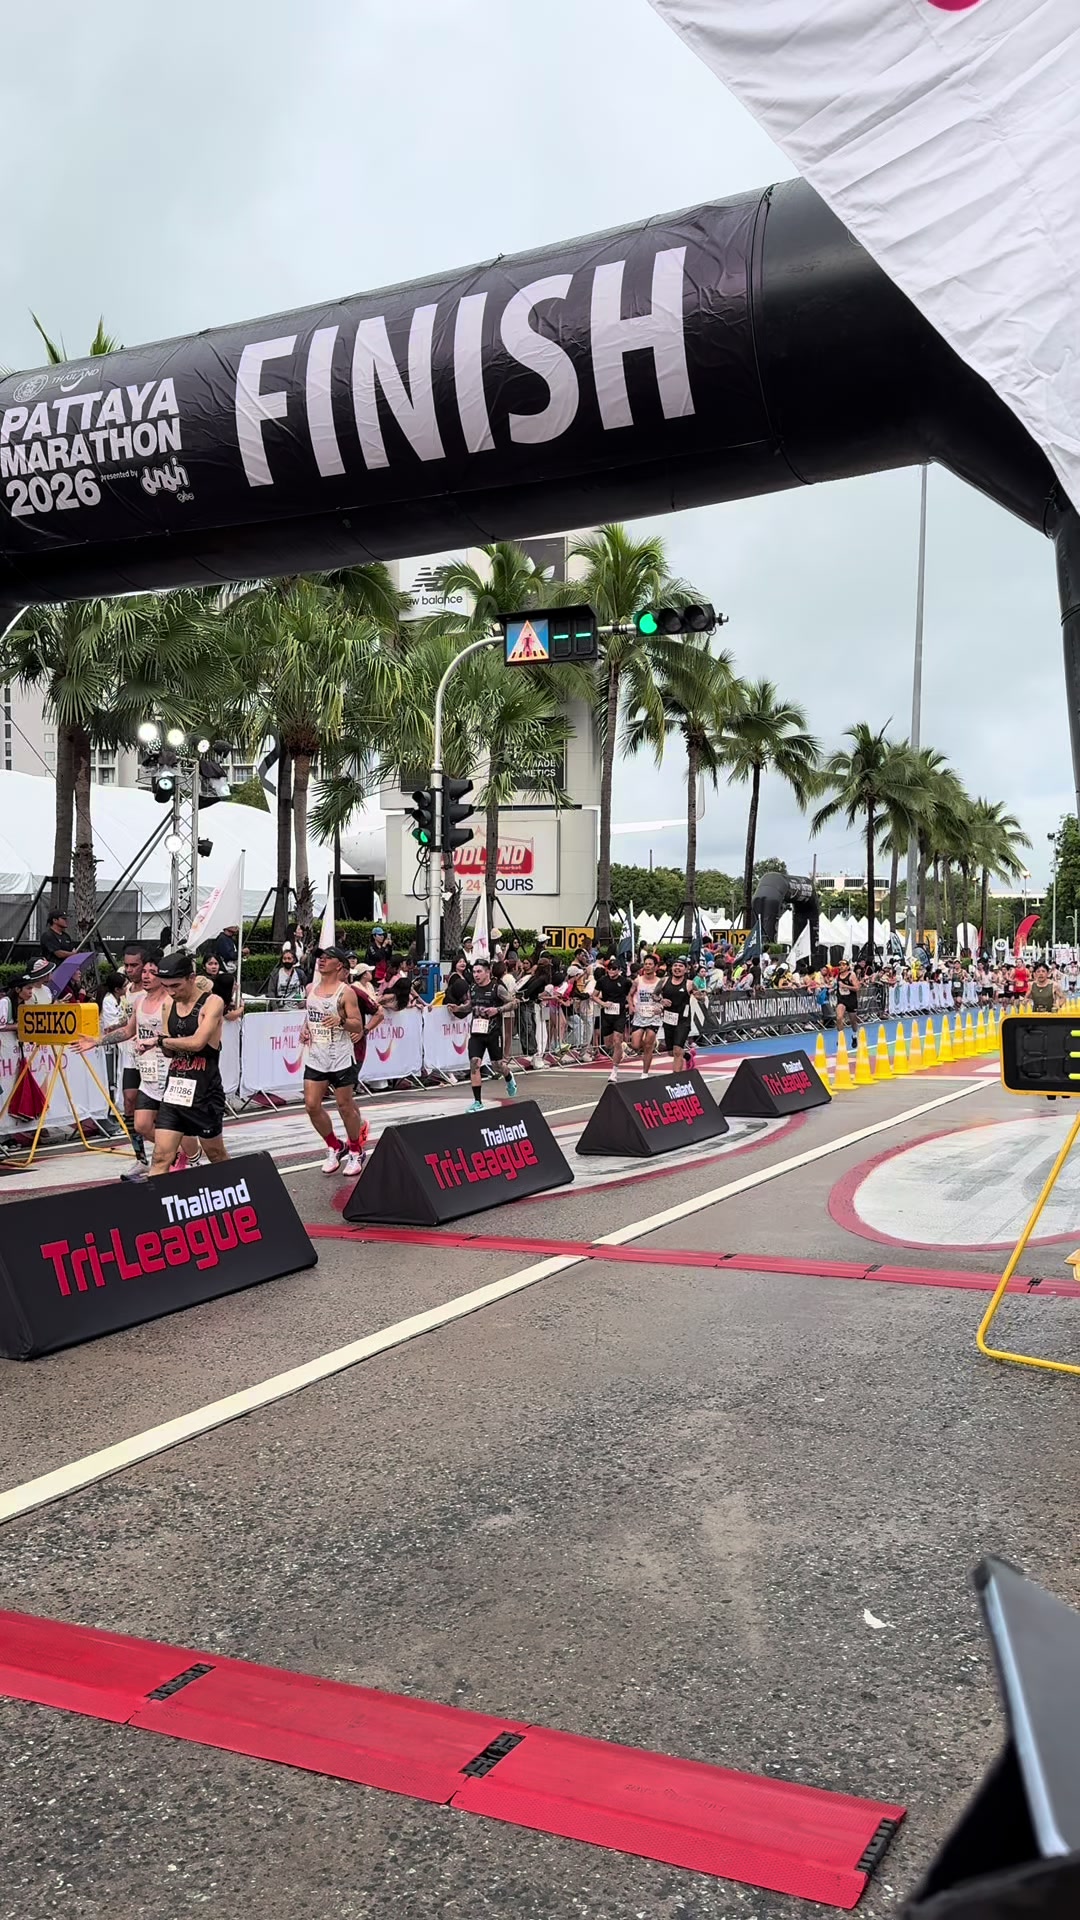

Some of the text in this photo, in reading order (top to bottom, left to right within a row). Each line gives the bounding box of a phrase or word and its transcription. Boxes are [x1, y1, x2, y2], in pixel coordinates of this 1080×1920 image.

[236, 246, 696, 487] FINISH
[0, 377, 180, 443] PATTAYA
[0, 417, 182, 477] MARATHON
[101, 469, 138, 482] presented by
[6, 469, 101, 517] 2026
[422, 594, 463, 606] balance
[466, 879, 481, 891] 24
[495, 878, 534, 892] OURS
[549, 931, 559, 946] T
[751, 997, 777, 1019] THAILAND
[24, 1011, 77, 1034] SEIKO
[782, 1059, 804, 1074] Thailand
[665, 1080, 695, 1099] Thailand
[762, 1071, 812, 1096] Tri-League
[634, 1095, 704, 1129] Tri-League
[480, 1120, 528, 1146] Thailand
[424, 1139, 539, 1189] Tri-League
[161, 1178, 251, 1223] Thailand
[40, 1205, 262, 1296] Tri-League
